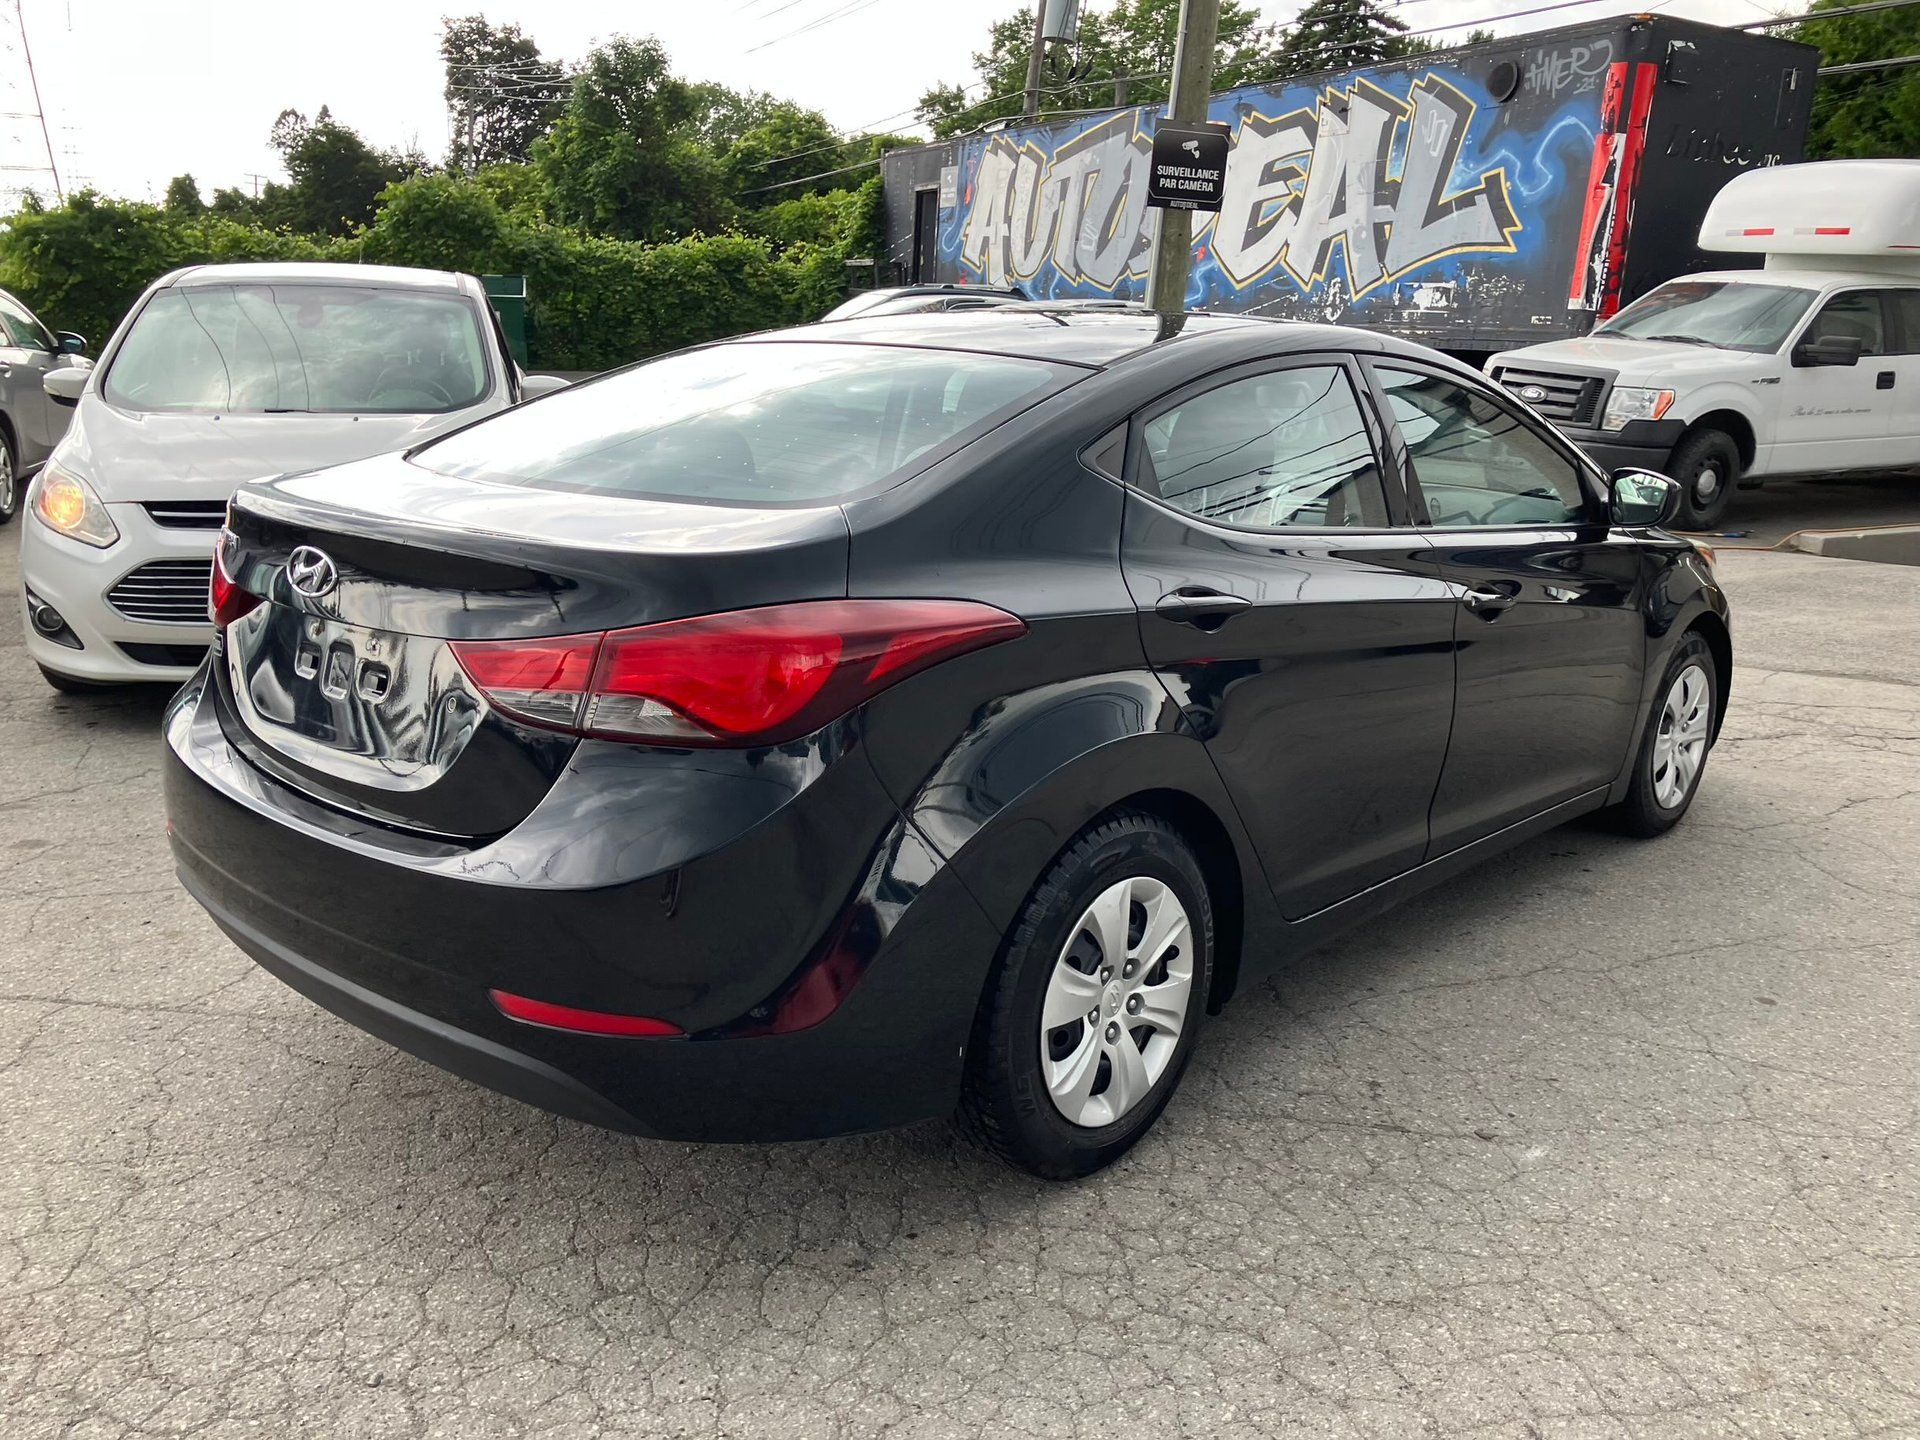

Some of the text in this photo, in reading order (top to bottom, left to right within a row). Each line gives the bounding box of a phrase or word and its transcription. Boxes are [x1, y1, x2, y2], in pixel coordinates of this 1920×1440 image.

[1157, 165, 1219, 180] SURVEILLANCE
[1159, 178, 1214, 192] PAR CAMÉRA
[1521, 387, 1545, 399] Ford
